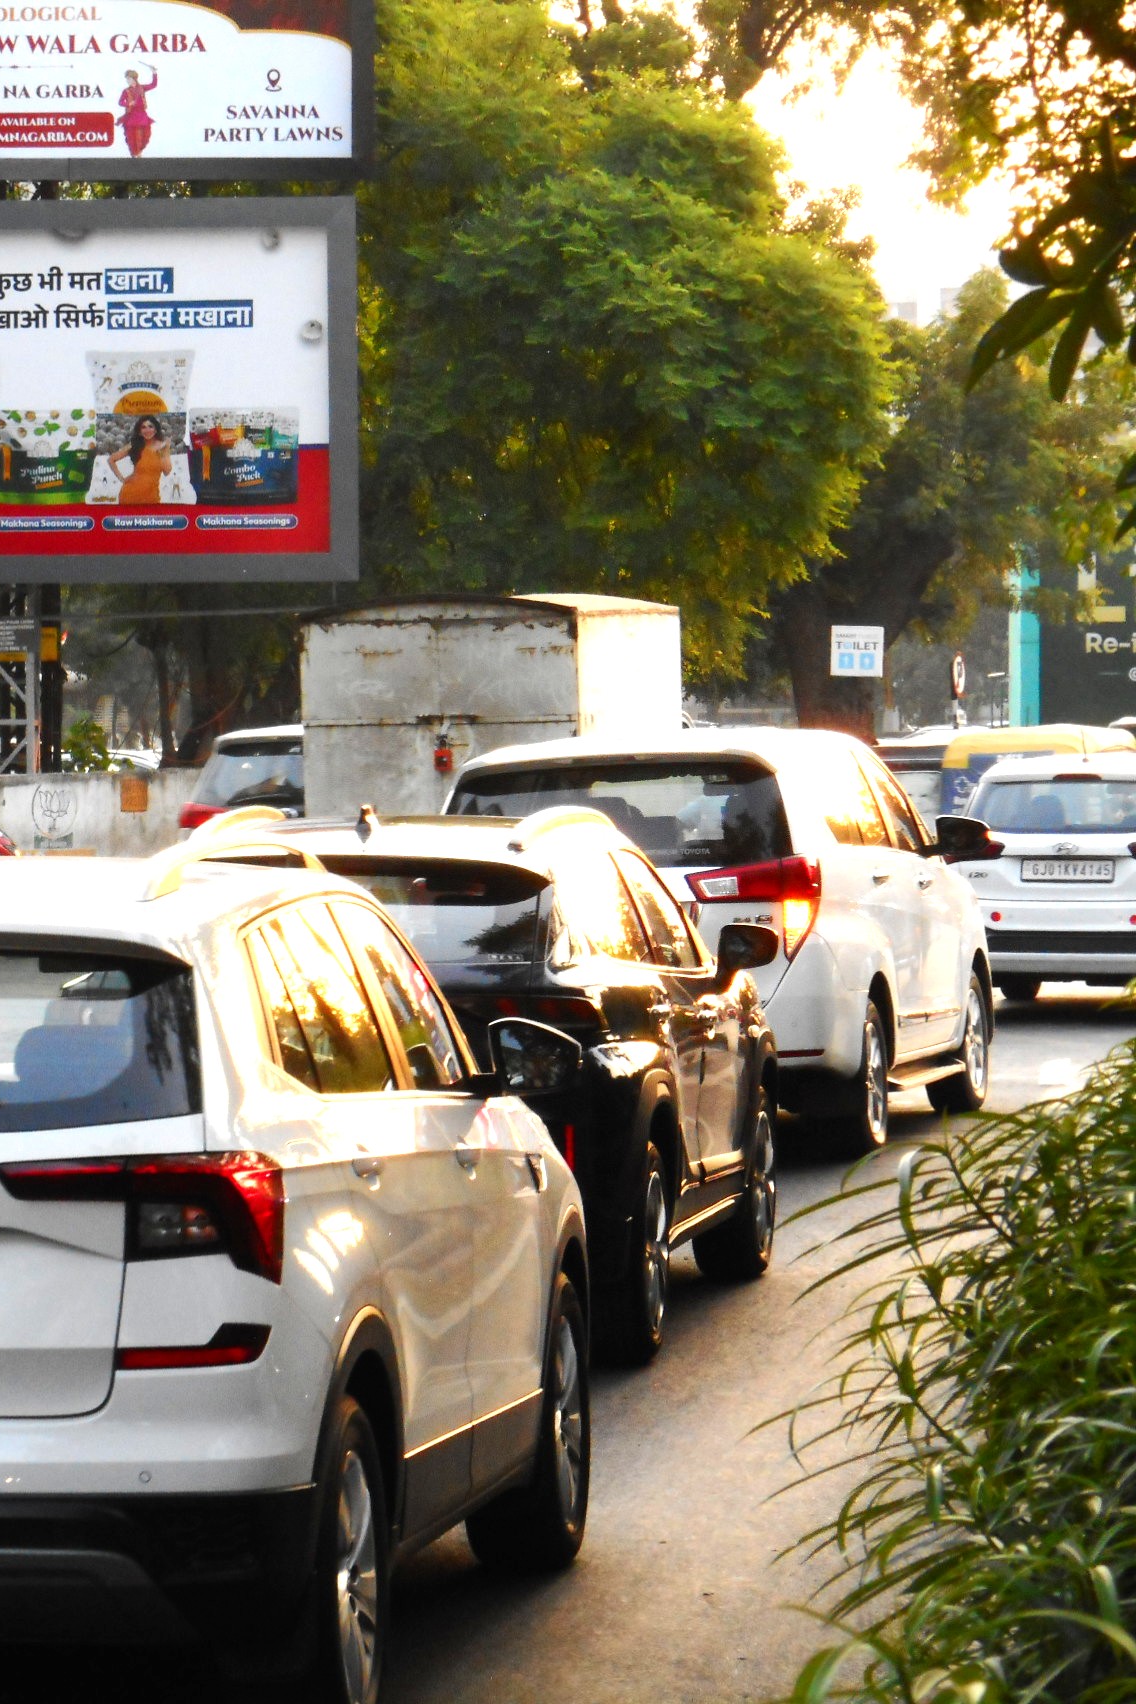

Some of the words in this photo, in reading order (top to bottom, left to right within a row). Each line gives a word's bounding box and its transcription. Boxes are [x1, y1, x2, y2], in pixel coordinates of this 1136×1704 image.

[26, 33, 103, 55] WALA
[109, 33, 207, 54] GARBA
[3, 85, 31, 99] NA
[35, 85, 104, 99] GARBA
[226, 104, 320, 120] SAVANNA
[0, 117, 56, 127] AVAILABLE
[58, 117, 76, 127] ON
[203, 127, 268, 142] PARTY
[273, 126, 344, 142] LAWNS
[38, 266, 63, 291] भी
[68, 272, 103, 291] मत
[106, 270, 169, 293] खाना,
[54, 303, 105, 329] सिर्फ
[108, 302, 174, 328] लोटस
[177, 305, 252, 328] मखाना
[223, 463, 256, 476] Combo
[0, 518, 39, 528] Makhana
[41, 518, 88, 530] Seasonings
[114, 518, 133, 527] Raw
[134, 517, 173, 526] Makhana
[202, 517, 242, 526] Makhana
[244, 517, 291, 528] Seasonings
[835, 641, 879, 651] TOILET
